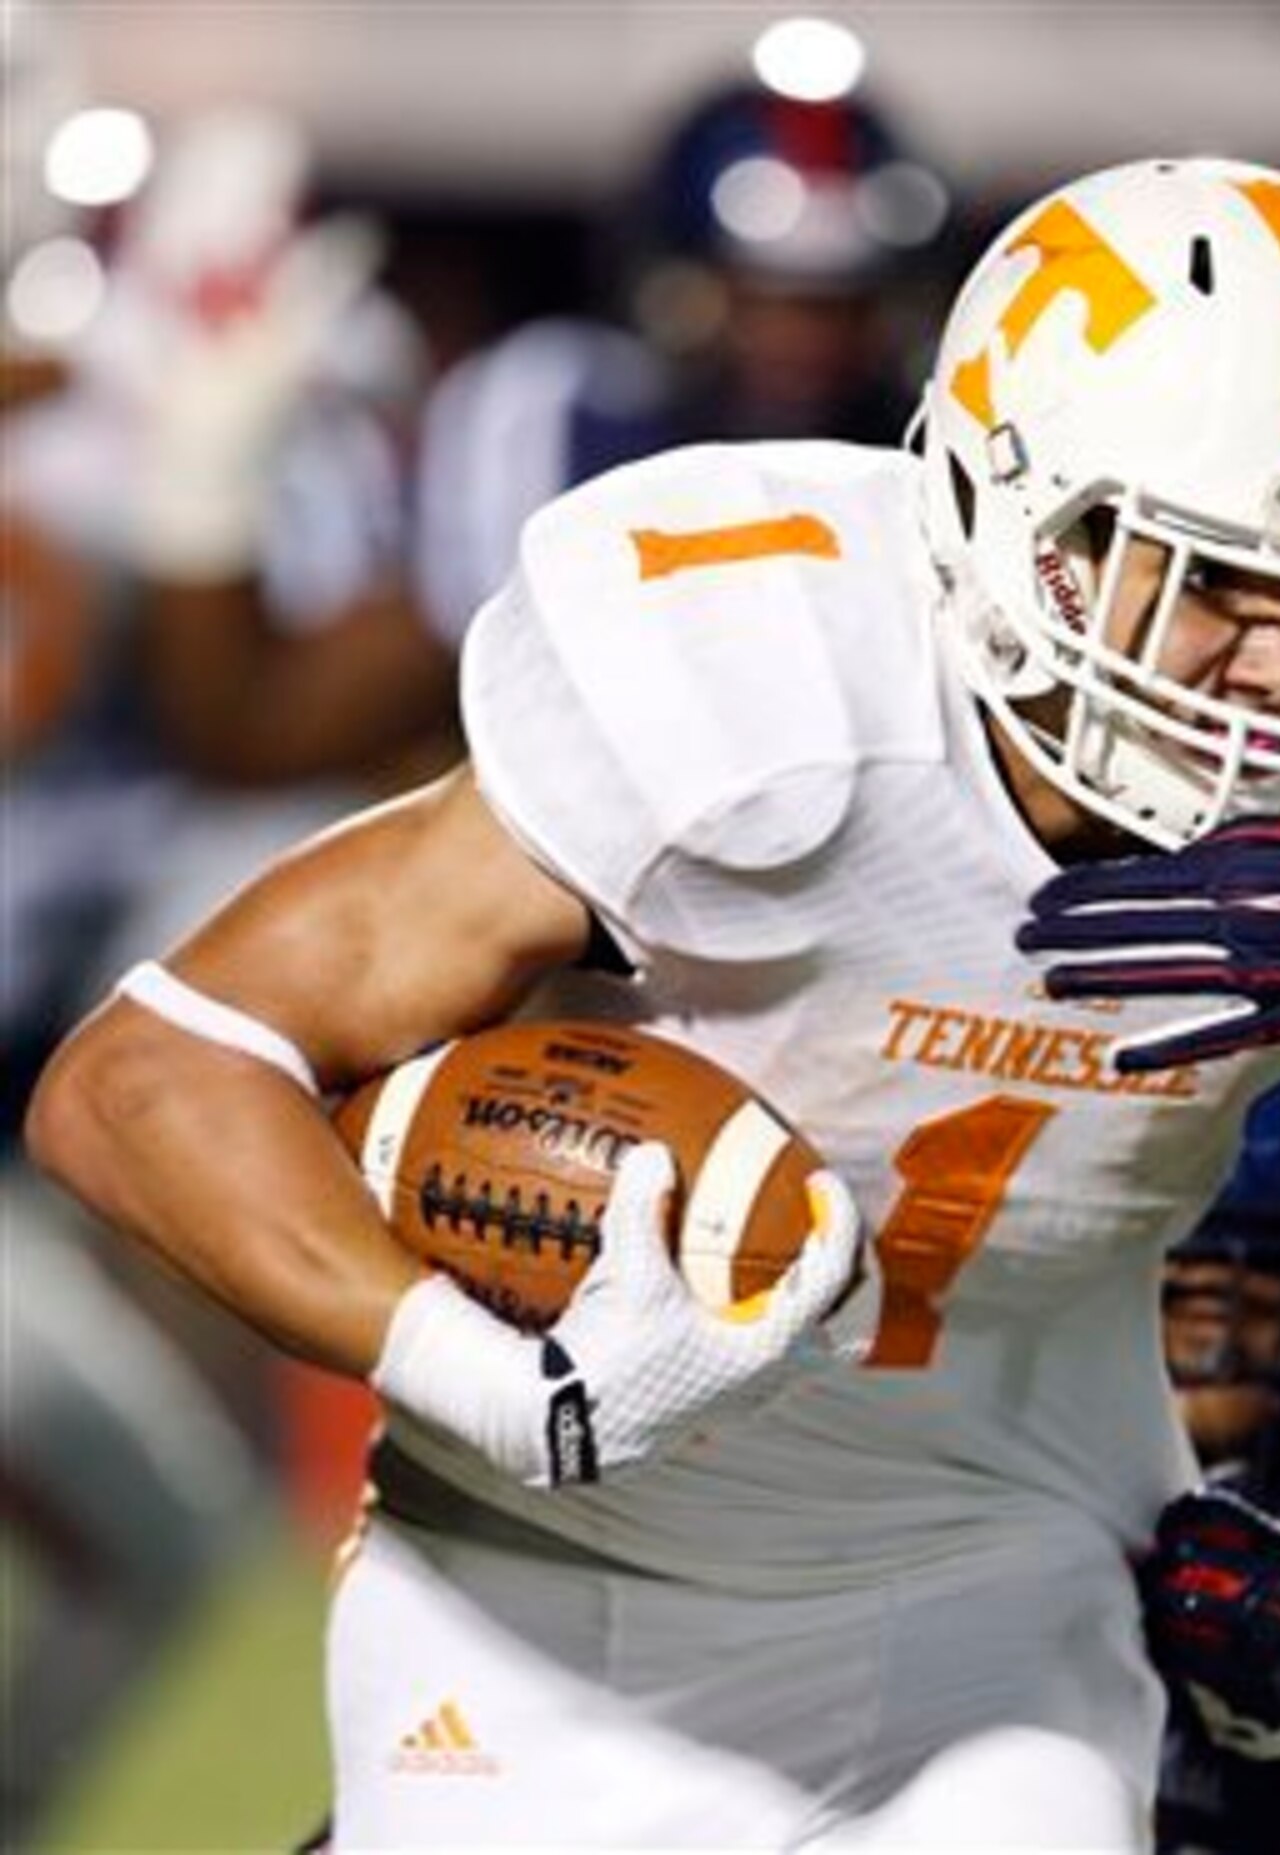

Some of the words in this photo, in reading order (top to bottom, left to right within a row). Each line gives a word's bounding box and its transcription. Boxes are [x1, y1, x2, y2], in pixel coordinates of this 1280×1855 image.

[630, 513, 842, 582] 1
[880, 998, 1198, 1098] TENNESE
[860, 1094, 1060, 1370] 1
